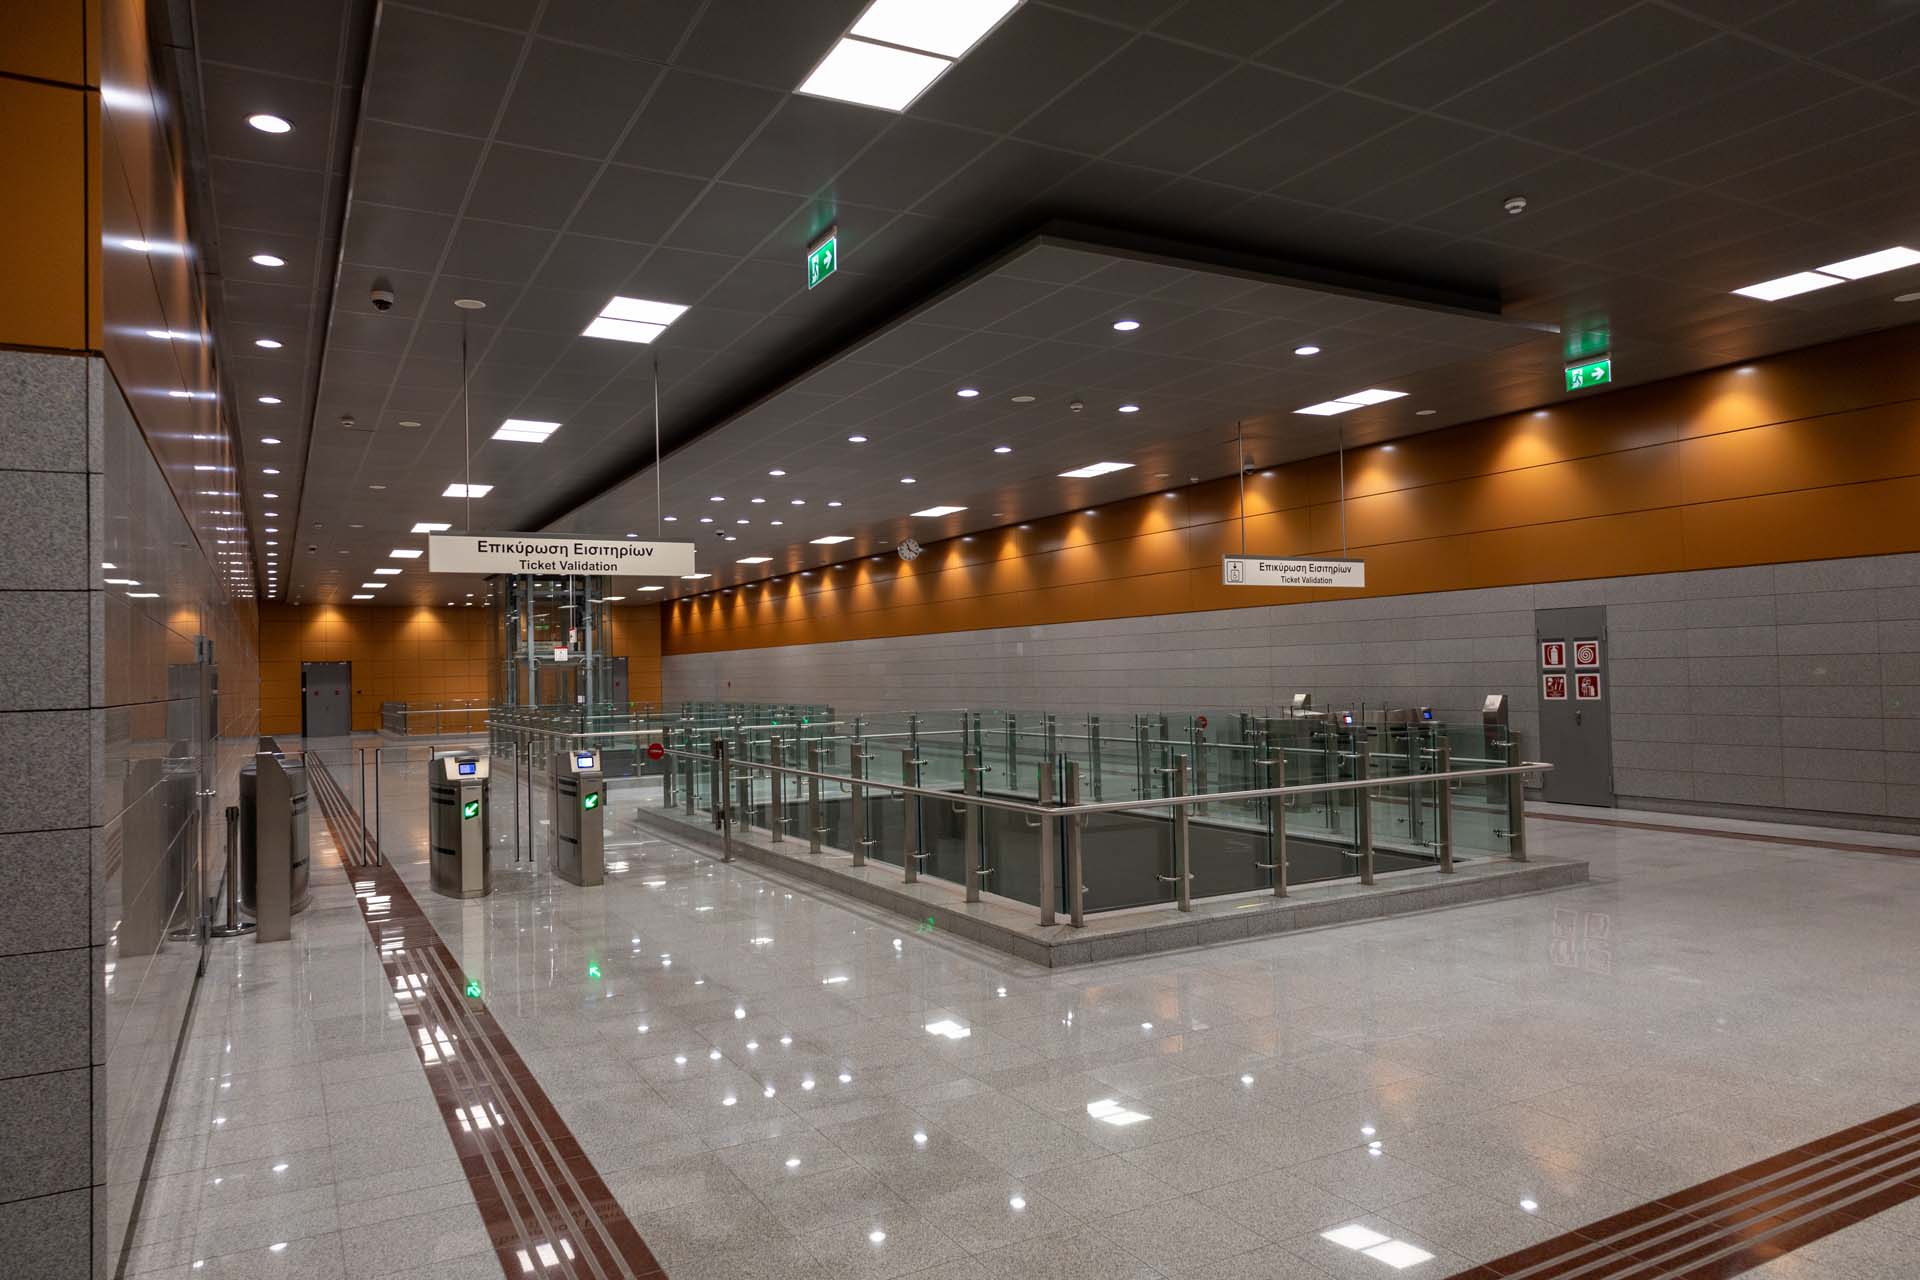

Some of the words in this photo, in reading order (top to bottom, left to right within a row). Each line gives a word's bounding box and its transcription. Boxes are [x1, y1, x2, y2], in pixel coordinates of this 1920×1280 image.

[477, 540, 569, 557] Επικύρωση
[574, 543, 654, 559] Εισιτηρίων
[519, 559, 557, 571] Ticket
[559, 560, 618, 572] Validation
[1259, 562, 1307, 574] Επικύρωση
[1309, 563, 1352, 574] Εισιτηρίων
